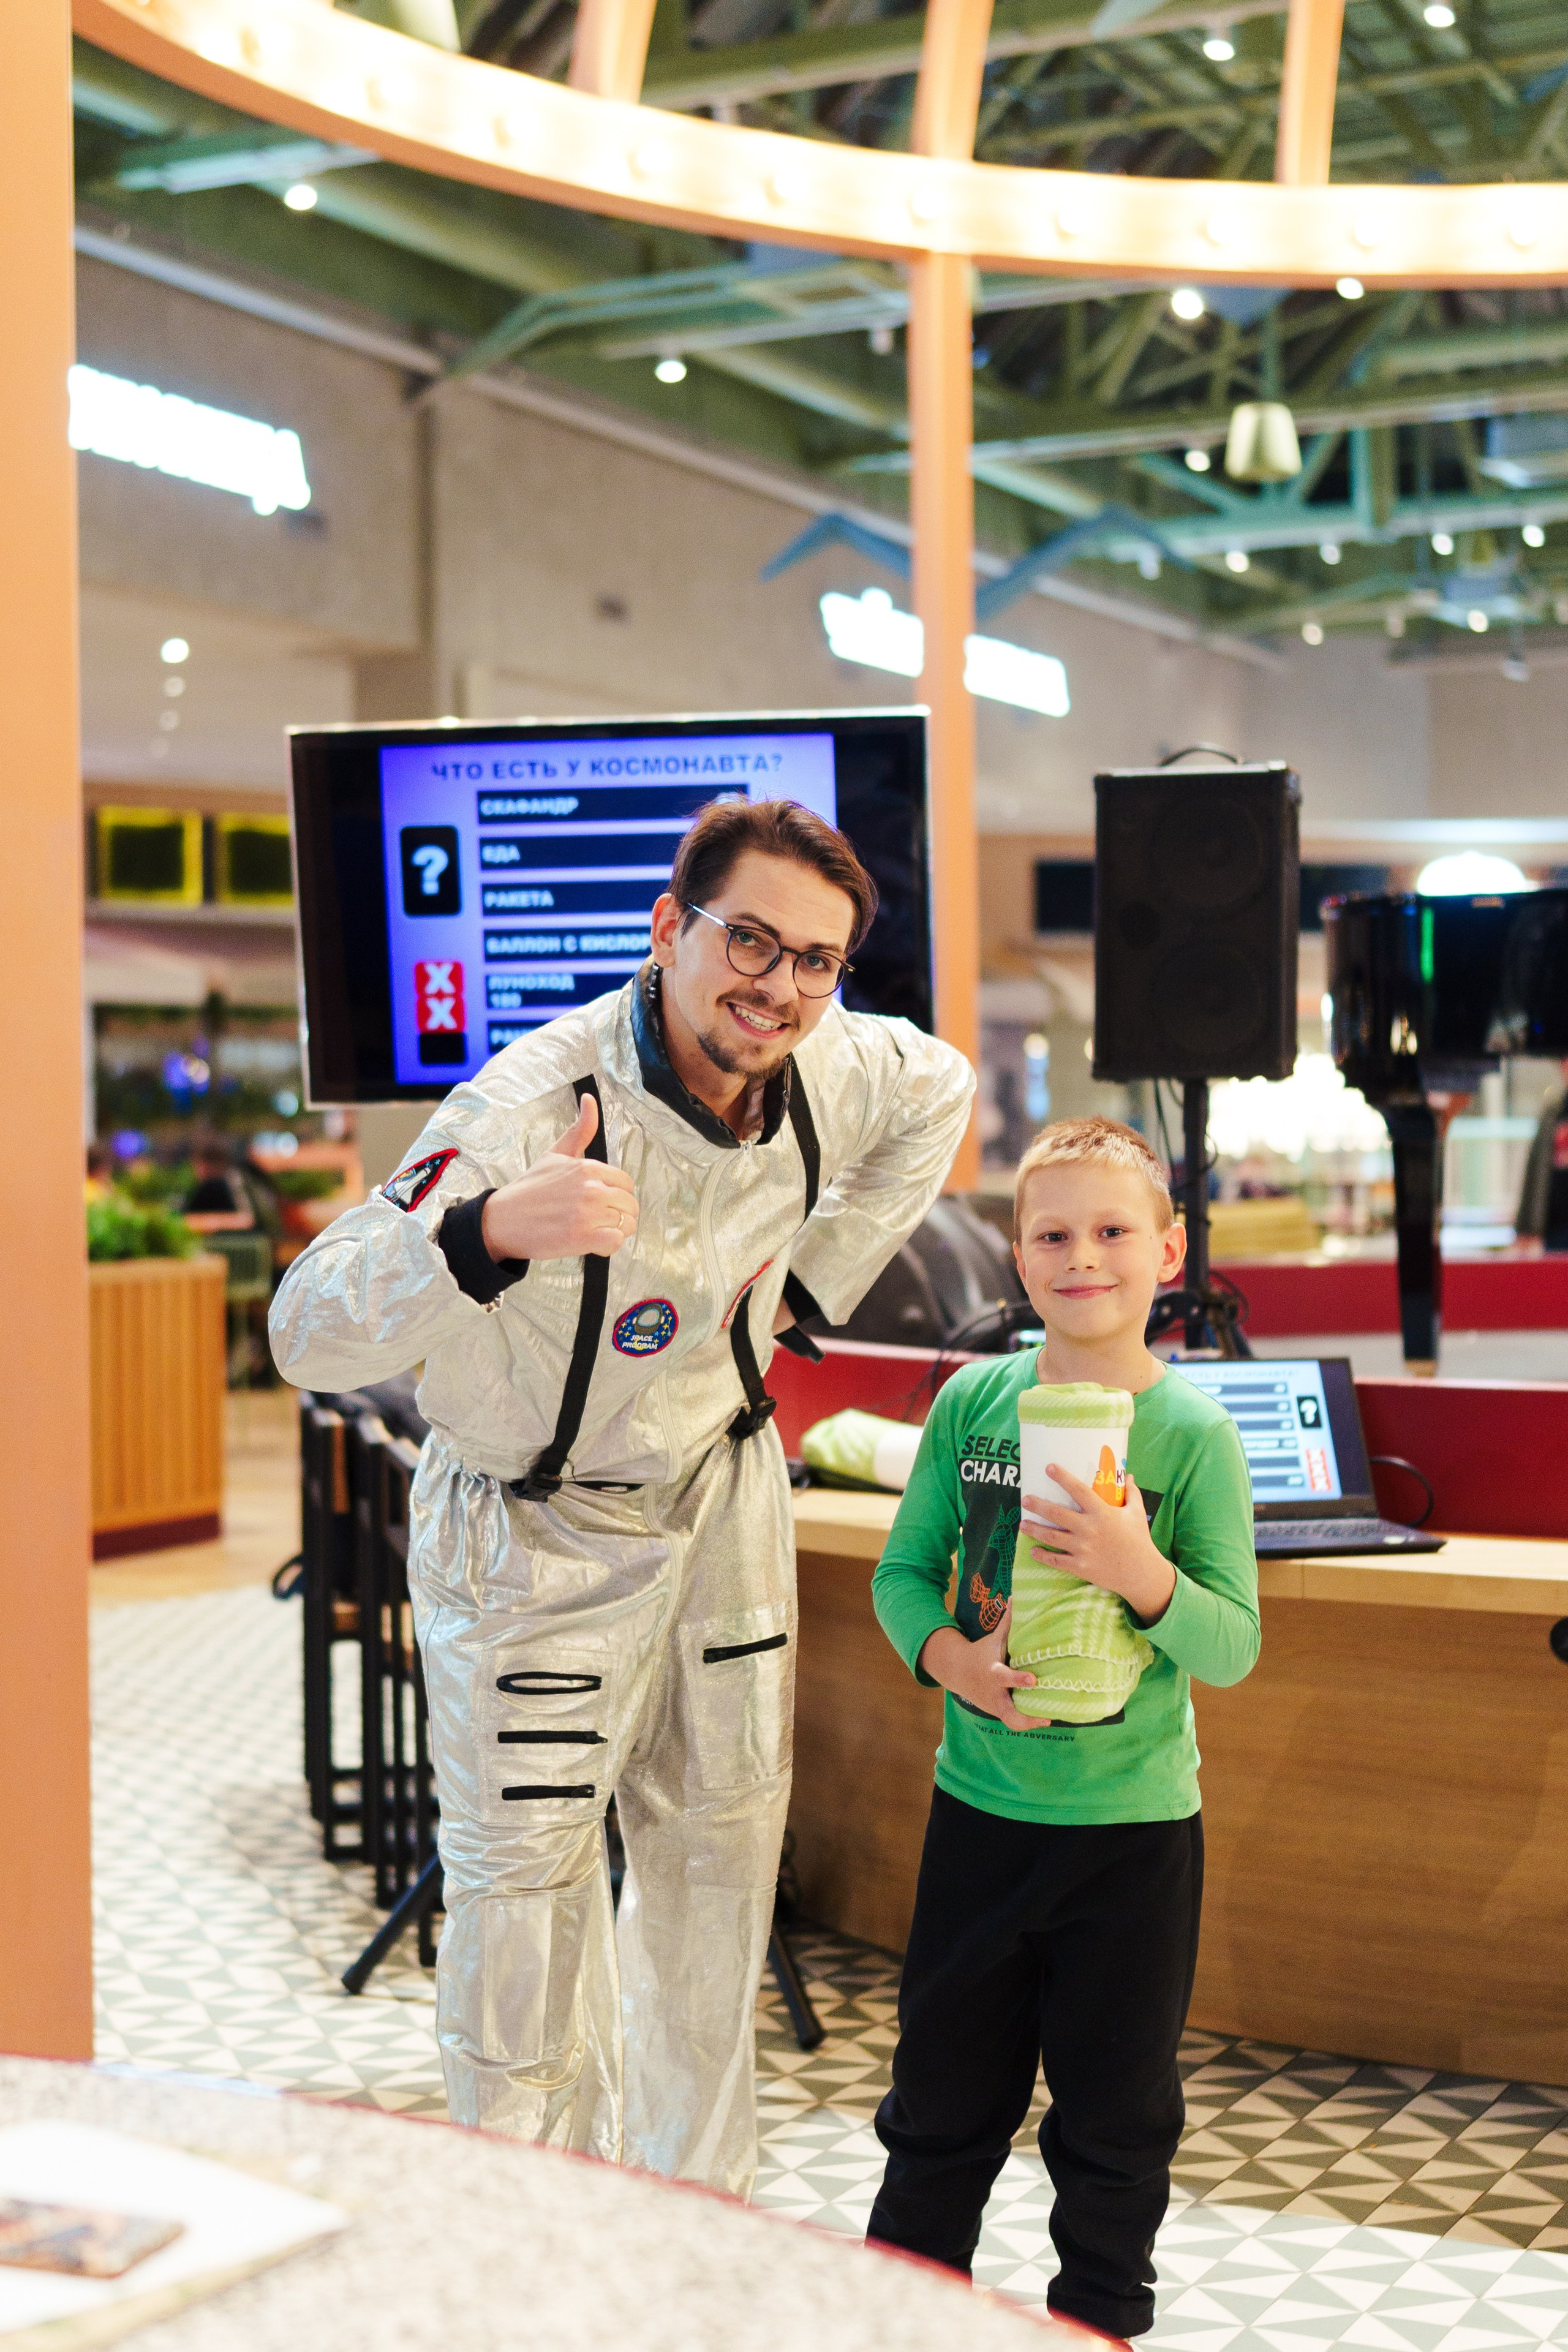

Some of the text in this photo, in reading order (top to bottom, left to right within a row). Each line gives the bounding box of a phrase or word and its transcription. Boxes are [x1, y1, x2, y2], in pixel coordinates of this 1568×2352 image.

[432, 753, 783, 780] ЧТО ЕСТЬ У КОСМОНАВТА?
[484, 890, 554, 908] РАКЕТА
[1023, 1732, 1075, 1741] ADVERSARY
